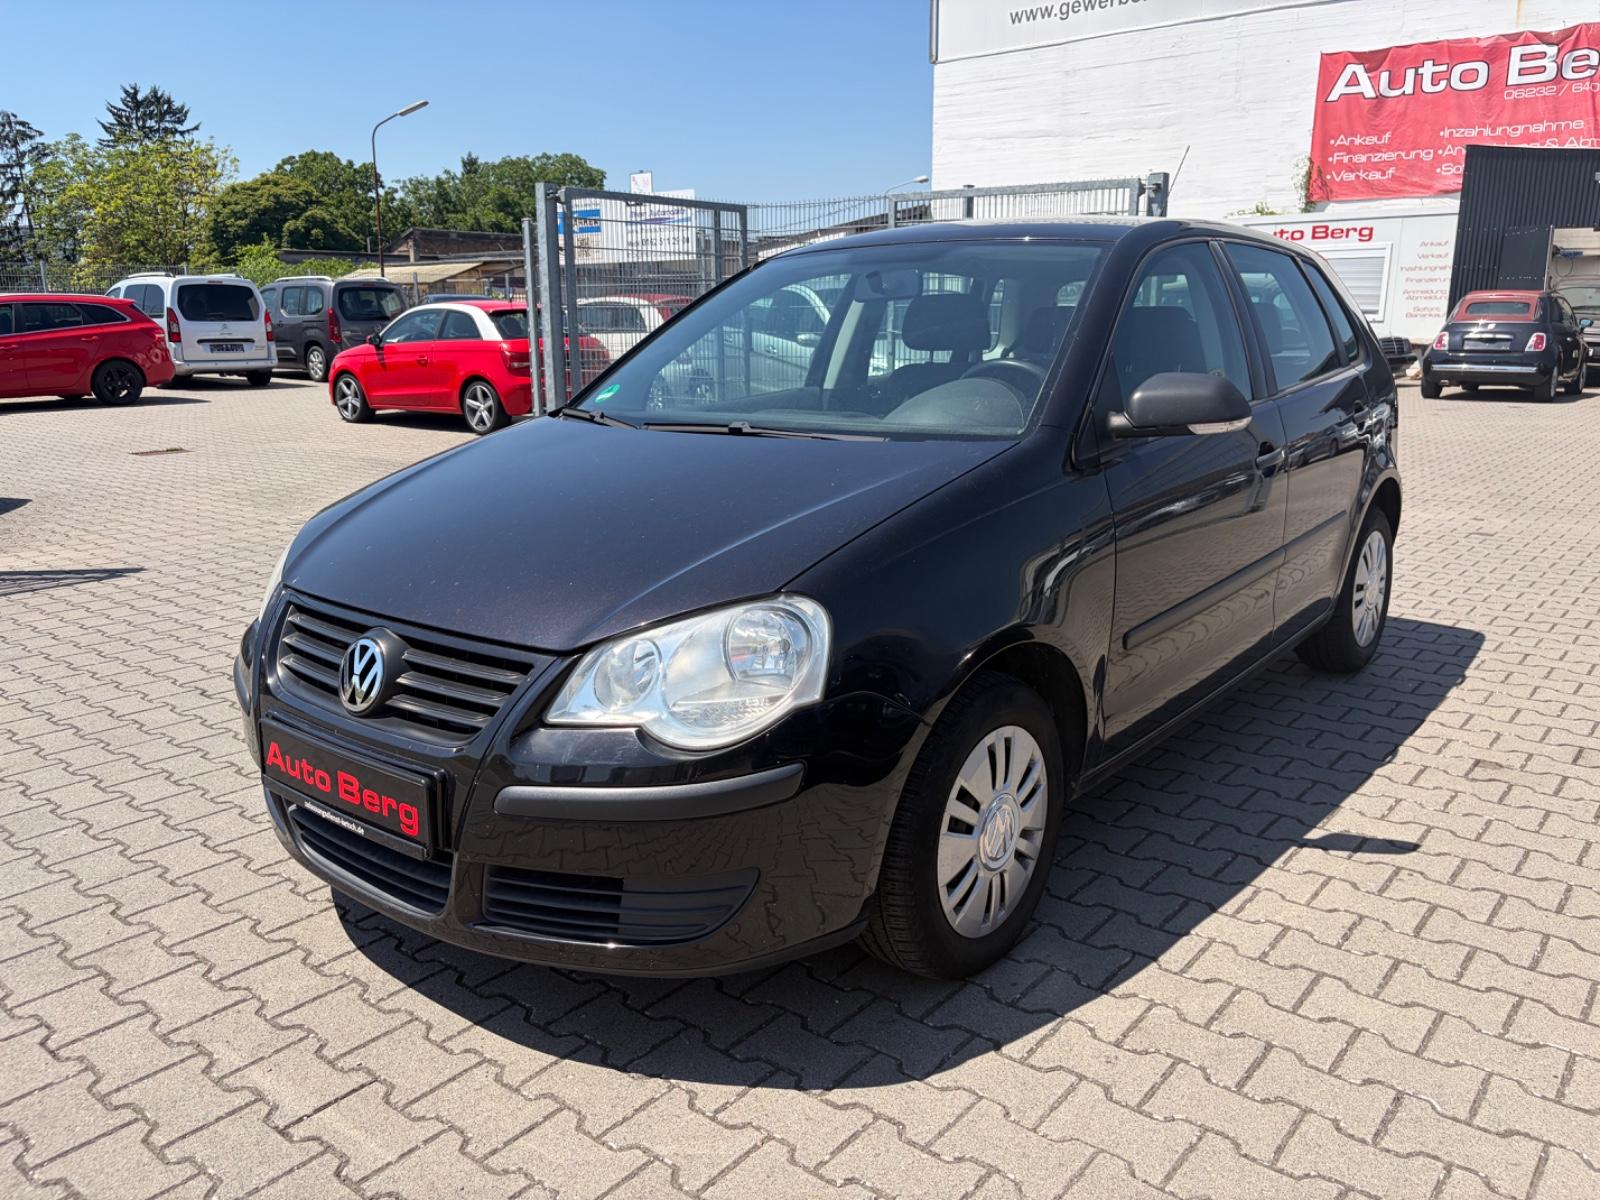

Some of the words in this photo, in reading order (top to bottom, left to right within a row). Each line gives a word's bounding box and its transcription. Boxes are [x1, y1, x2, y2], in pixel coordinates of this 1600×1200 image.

[1009, 0, 1147, 25] www.gewer
[1325, 59, 1490, 102] Auto
[1504, 85, 1557, 100] 06232
[1444, 119, 1585, 138] Inzahlungnahme
[1334, 131, 1392, 147] Ankauf
[1333, 148, 1434, 165] Finanzierung
[1331, 167, 1396, 182] Verkauf
[1311, 225, 1374, 242] Berg
[266, 741, 332, 793] Auto
[337, 770, 419, 837] Berg
